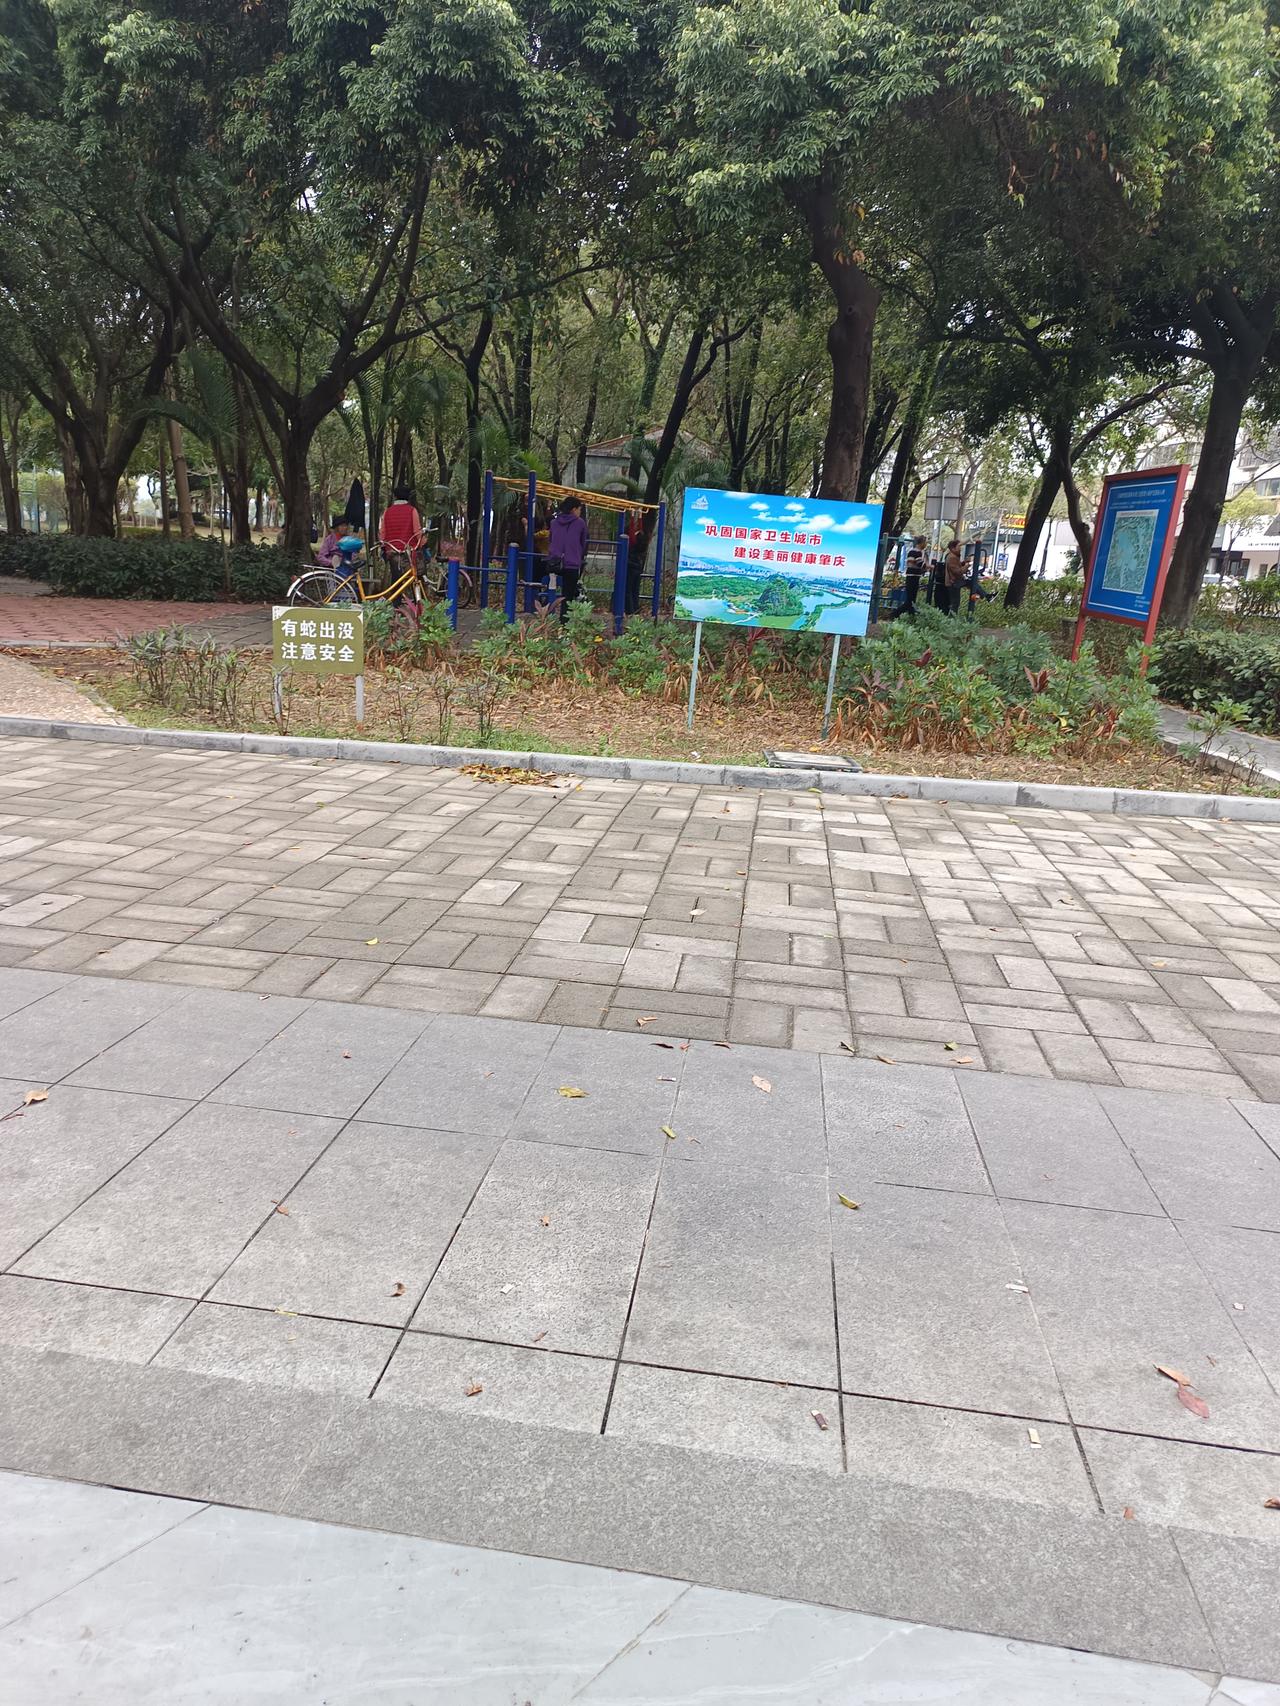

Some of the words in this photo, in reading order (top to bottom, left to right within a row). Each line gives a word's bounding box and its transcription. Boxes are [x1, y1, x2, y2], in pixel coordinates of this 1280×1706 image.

[704, 525, 823, 546] 巩固国家卫生城市
[734, 546, 846, 567] 建设美丽健康肇庆
[281, 619, 354, 640] 有蛇出没
[281, 642, 355, 662] 注意安全
